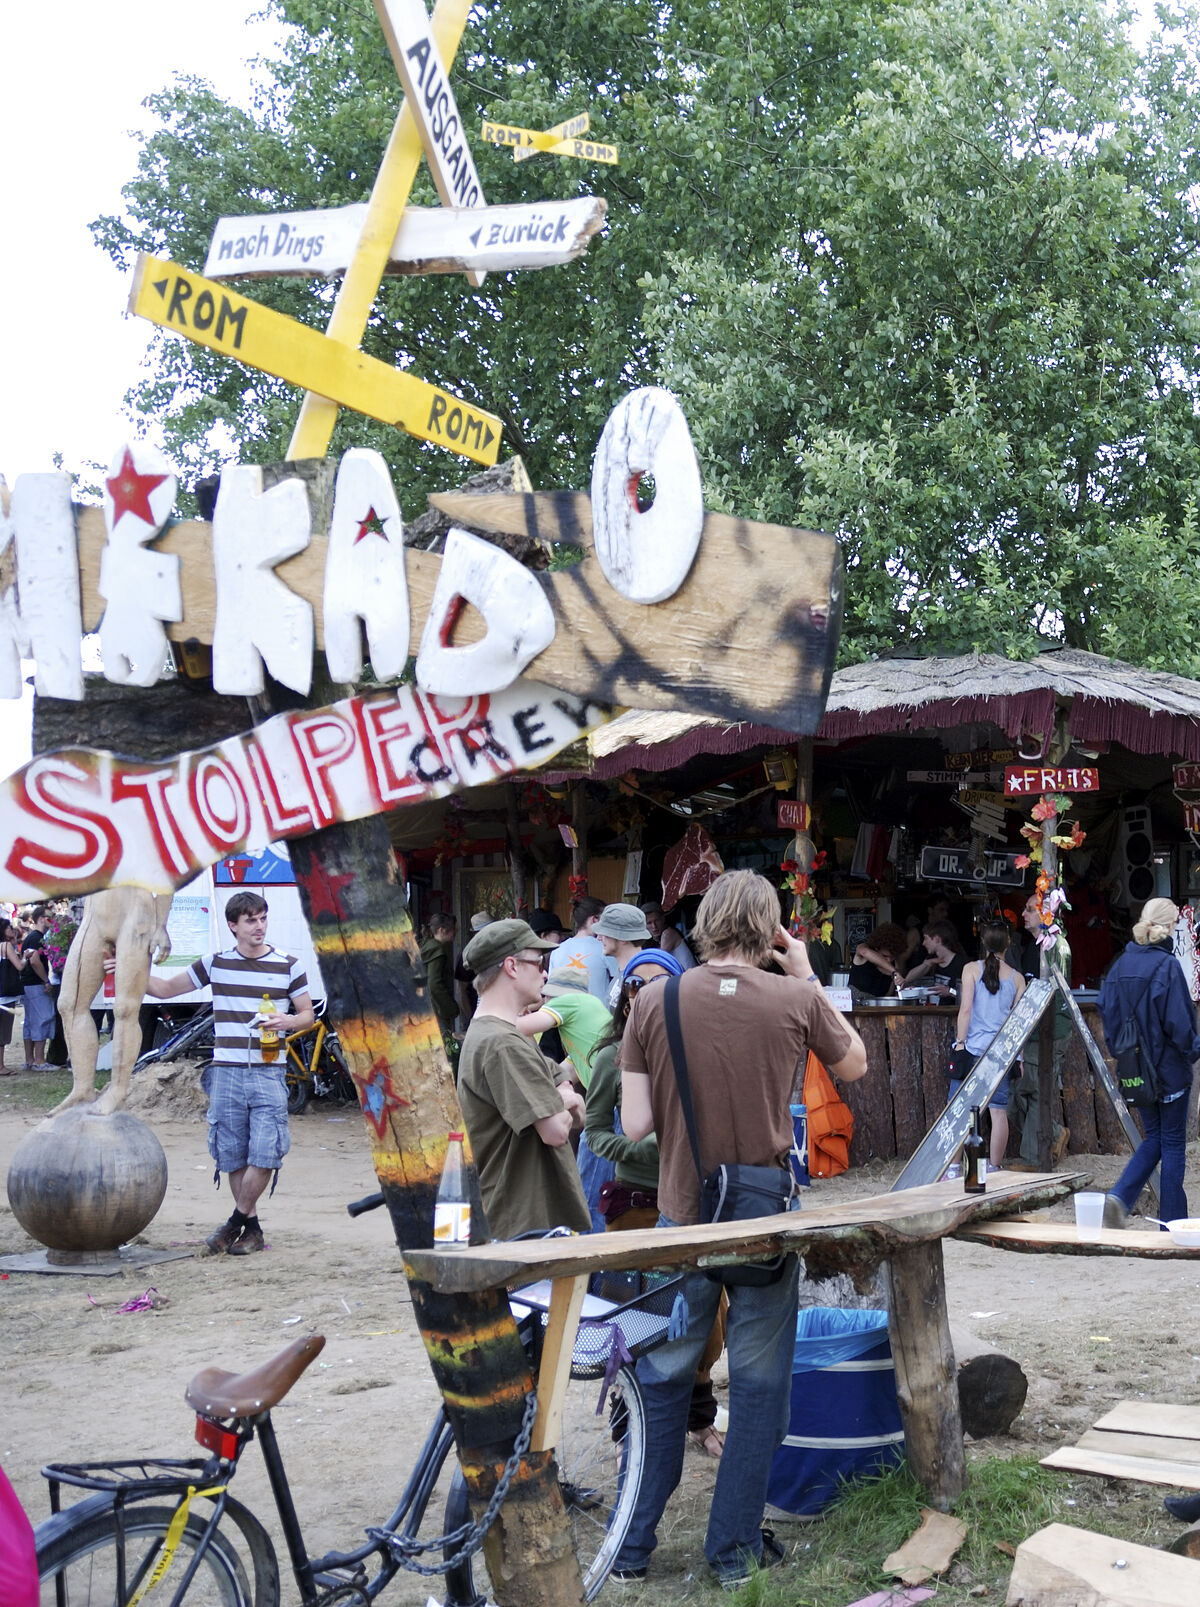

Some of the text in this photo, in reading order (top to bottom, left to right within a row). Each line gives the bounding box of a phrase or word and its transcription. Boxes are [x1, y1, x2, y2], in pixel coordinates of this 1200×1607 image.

[486, 126, 522, 145] ROM
[574, 142, 607, 160] ROM
[218, 222, 325, 262] nach Dings
[166, 276, 249, 350] ROM
[427, 394, 484, 451] ROM
[779, 804, 803, 825] CHAI
